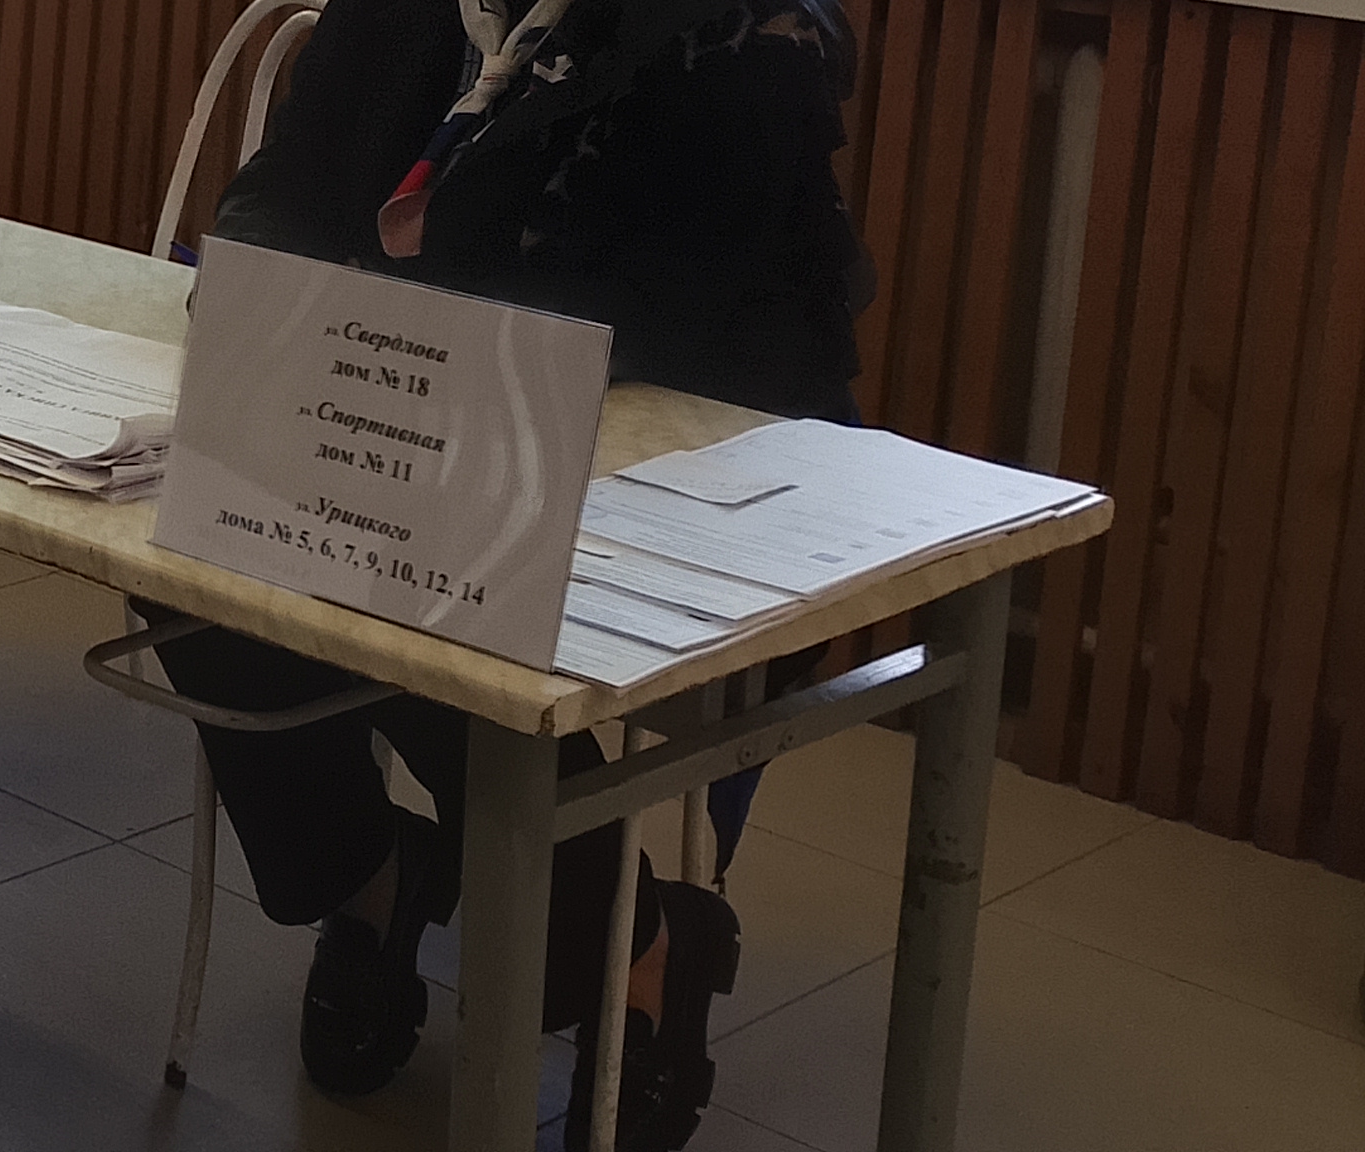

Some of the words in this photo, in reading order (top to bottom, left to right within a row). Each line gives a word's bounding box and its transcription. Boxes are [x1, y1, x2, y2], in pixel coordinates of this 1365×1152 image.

[343, 321, 450, 364] Свердлова
[331, 359, 370, 383] дом
[375, 366, 401, 391] №
[407, 374, 431, 398] 18
[316, 401, 447, 453] Спортивная
[315, 443, 355, 466] дом
[360, 451, 386, 475] №
[390, 460, 413, 483] 11
[315, 496, 412, 542] Урицкого
[215, 509, 264, 536] дома
[269, 520, 293, 545] №
[296, 530, 313, 554] 5,
[320, 538, 336, 562] 6,
[344, 543, 359, 568] 7,
[366, 550, 382, 577] 9,
[390, 559, 418, 588] 10,
[425, 569, 453, 597] 12,
[459, 581, 486, 606] 14
